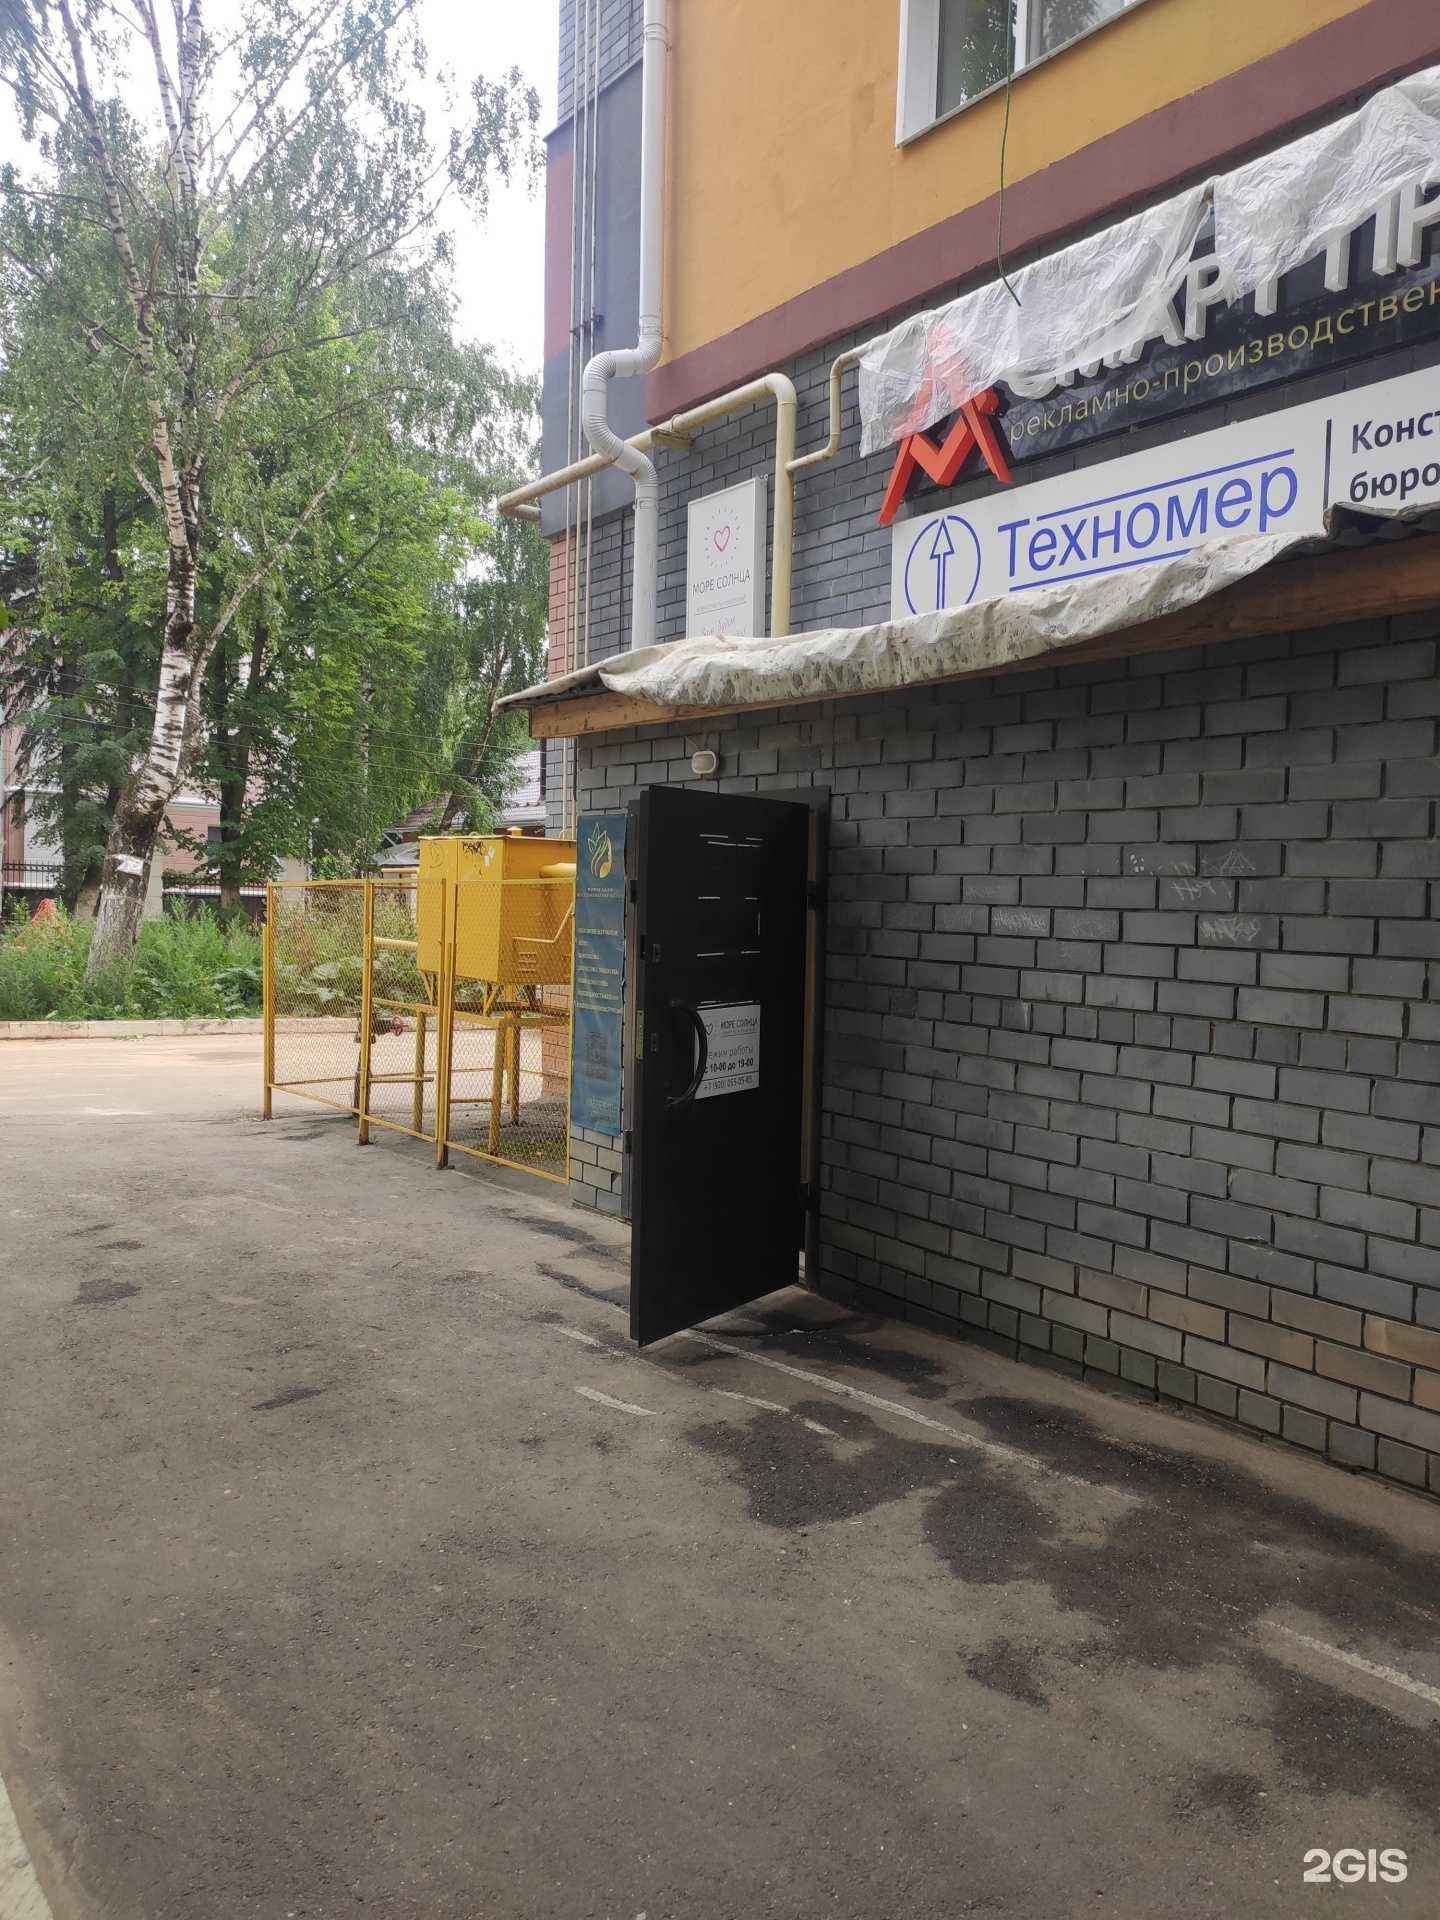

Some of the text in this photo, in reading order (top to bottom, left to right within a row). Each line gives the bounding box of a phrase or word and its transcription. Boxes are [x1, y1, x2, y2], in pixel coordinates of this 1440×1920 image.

[1352, 410, 1440, 454] Конс
[1350, 462, 1440, 502] бюро
[997, 466, 1298, 577] Техномер
[692, 567, 751, 597] МОРЕ СОЛНЦА
[710, 1062, 727, 1073] 10-00
[727, 1062, 736, 1071] до
